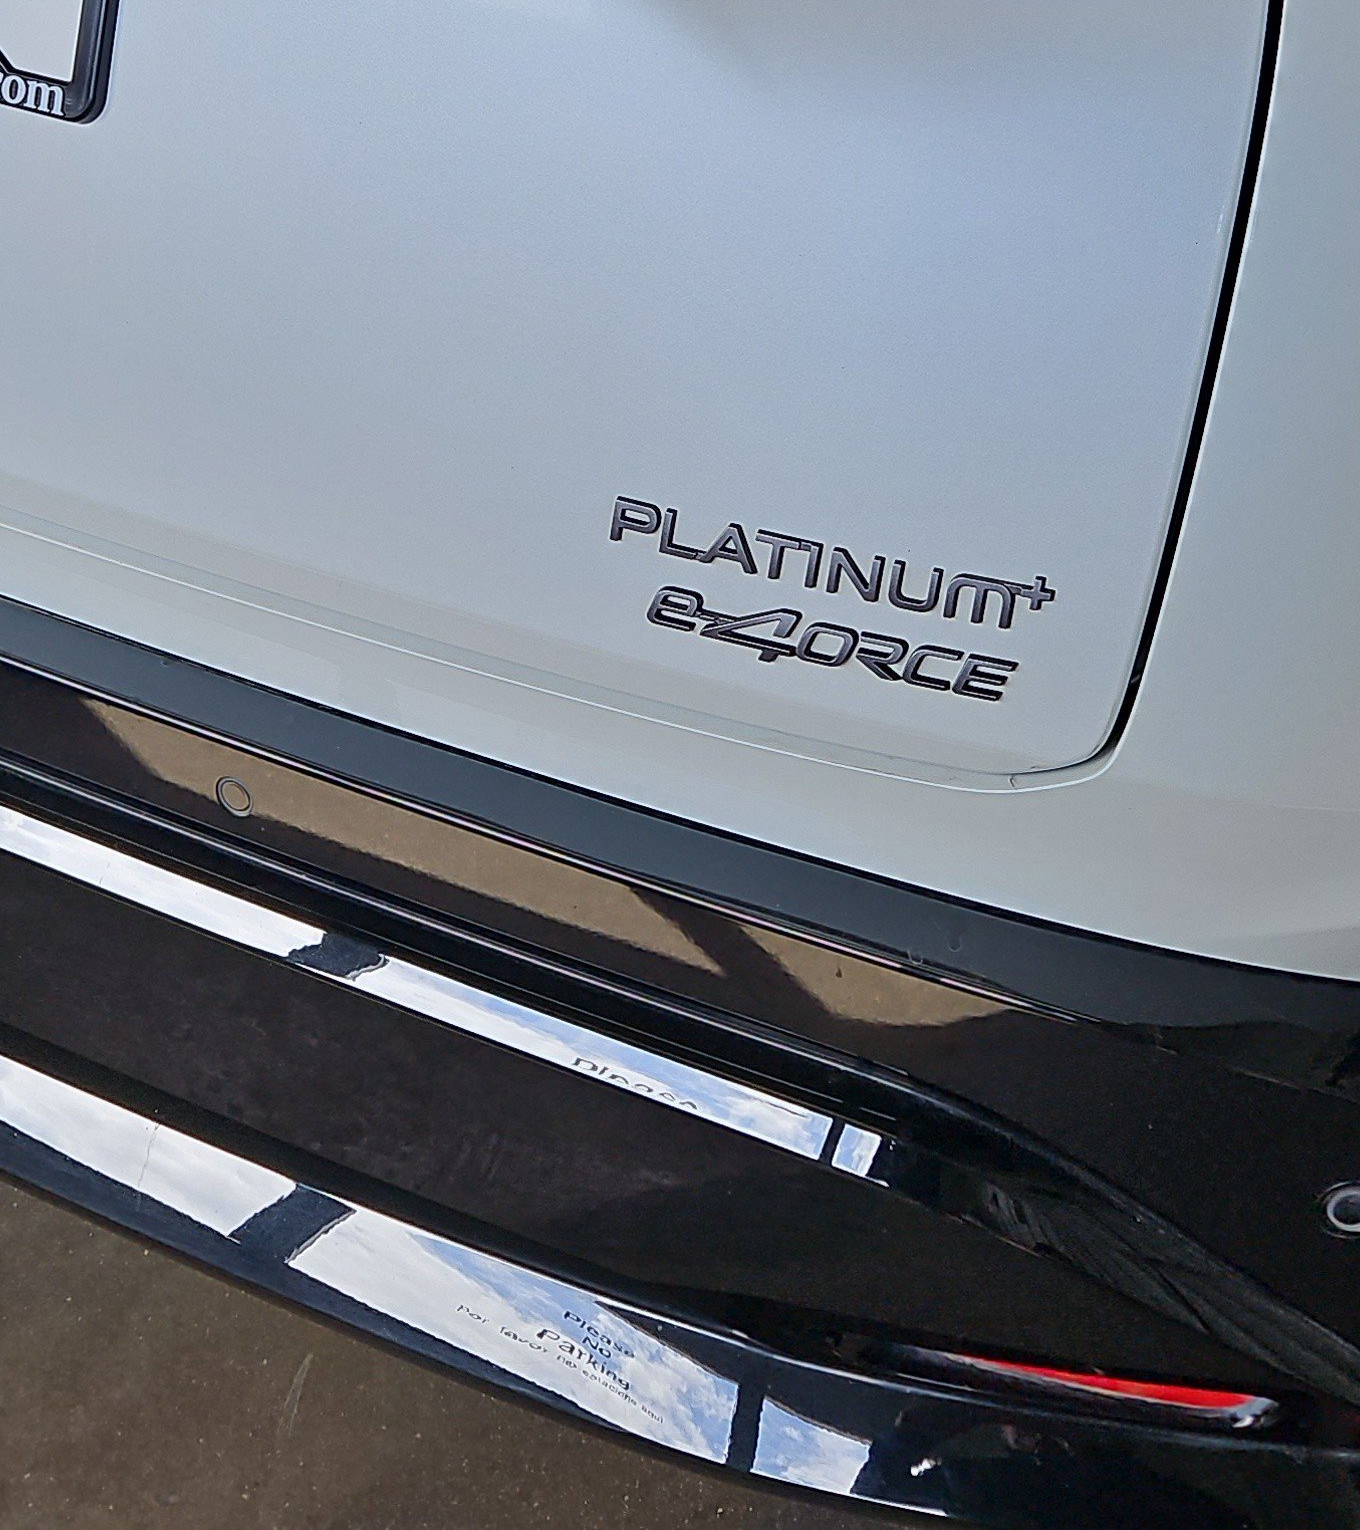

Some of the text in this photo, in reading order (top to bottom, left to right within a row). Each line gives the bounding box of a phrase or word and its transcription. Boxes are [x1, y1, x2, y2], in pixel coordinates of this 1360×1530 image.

[563, 1310, 636, 1359] Please
[581, 1336, 613, 1359] No
[536, 1328, 630, 1391] Parking
